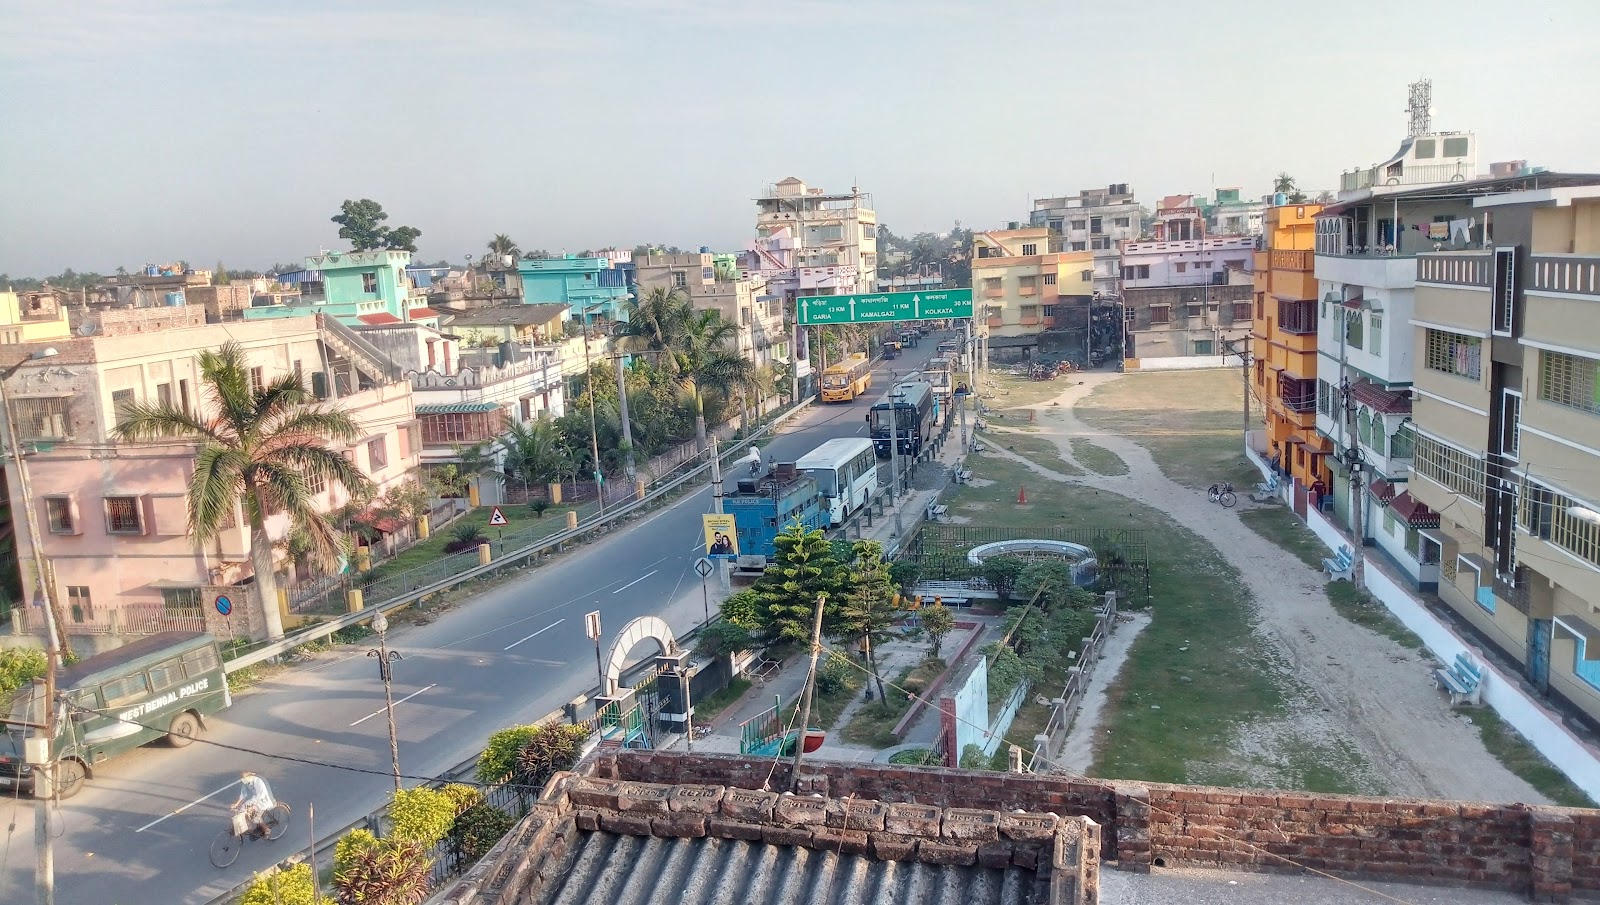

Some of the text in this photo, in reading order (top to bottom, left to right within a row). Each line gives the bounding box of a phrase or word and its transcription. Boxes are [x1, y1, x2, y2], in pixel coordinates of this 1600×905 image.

[119, 678, 209, 723] WEST BENGAL POLICE
